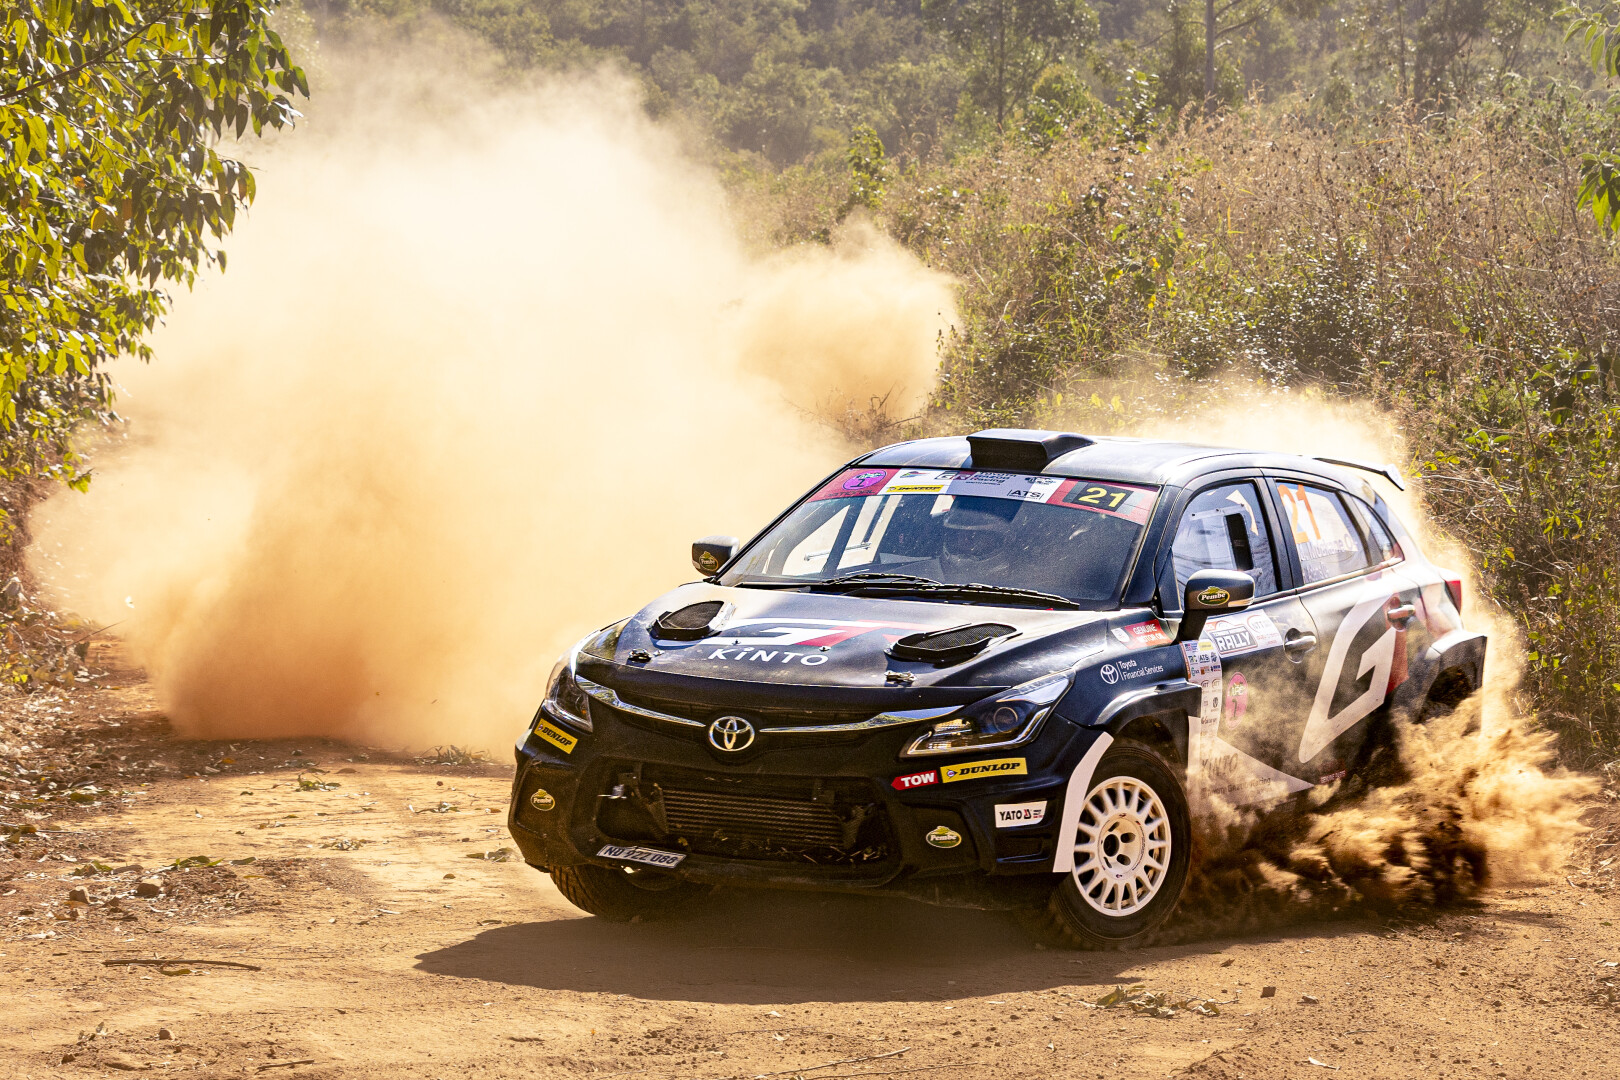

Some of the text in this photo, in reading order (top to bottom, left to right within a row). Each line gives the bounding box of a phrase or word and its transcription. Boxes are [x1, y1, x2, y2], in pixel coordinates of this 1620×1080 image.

[1078, 487, 1127, 508] 21
[1277, 484, 1321, 545] 21
[1201, 592, 1226, 601] Pembe
[1132, 623, 1158, 635] GENUINE
[1216, 631, 1252, 652] RALLY
[1118, 659, 1137, 671] Toyota
[1122, 665, 1164, 680] Financial Services
[542, 727, 573, 746] DUNLOP
[959, 762, 1021, 776] DUNLOP
[901, 772, 936, 788] TOW
[999, 809, 1022, 821] YATO
[930, 833, 958, 842] Pembe
